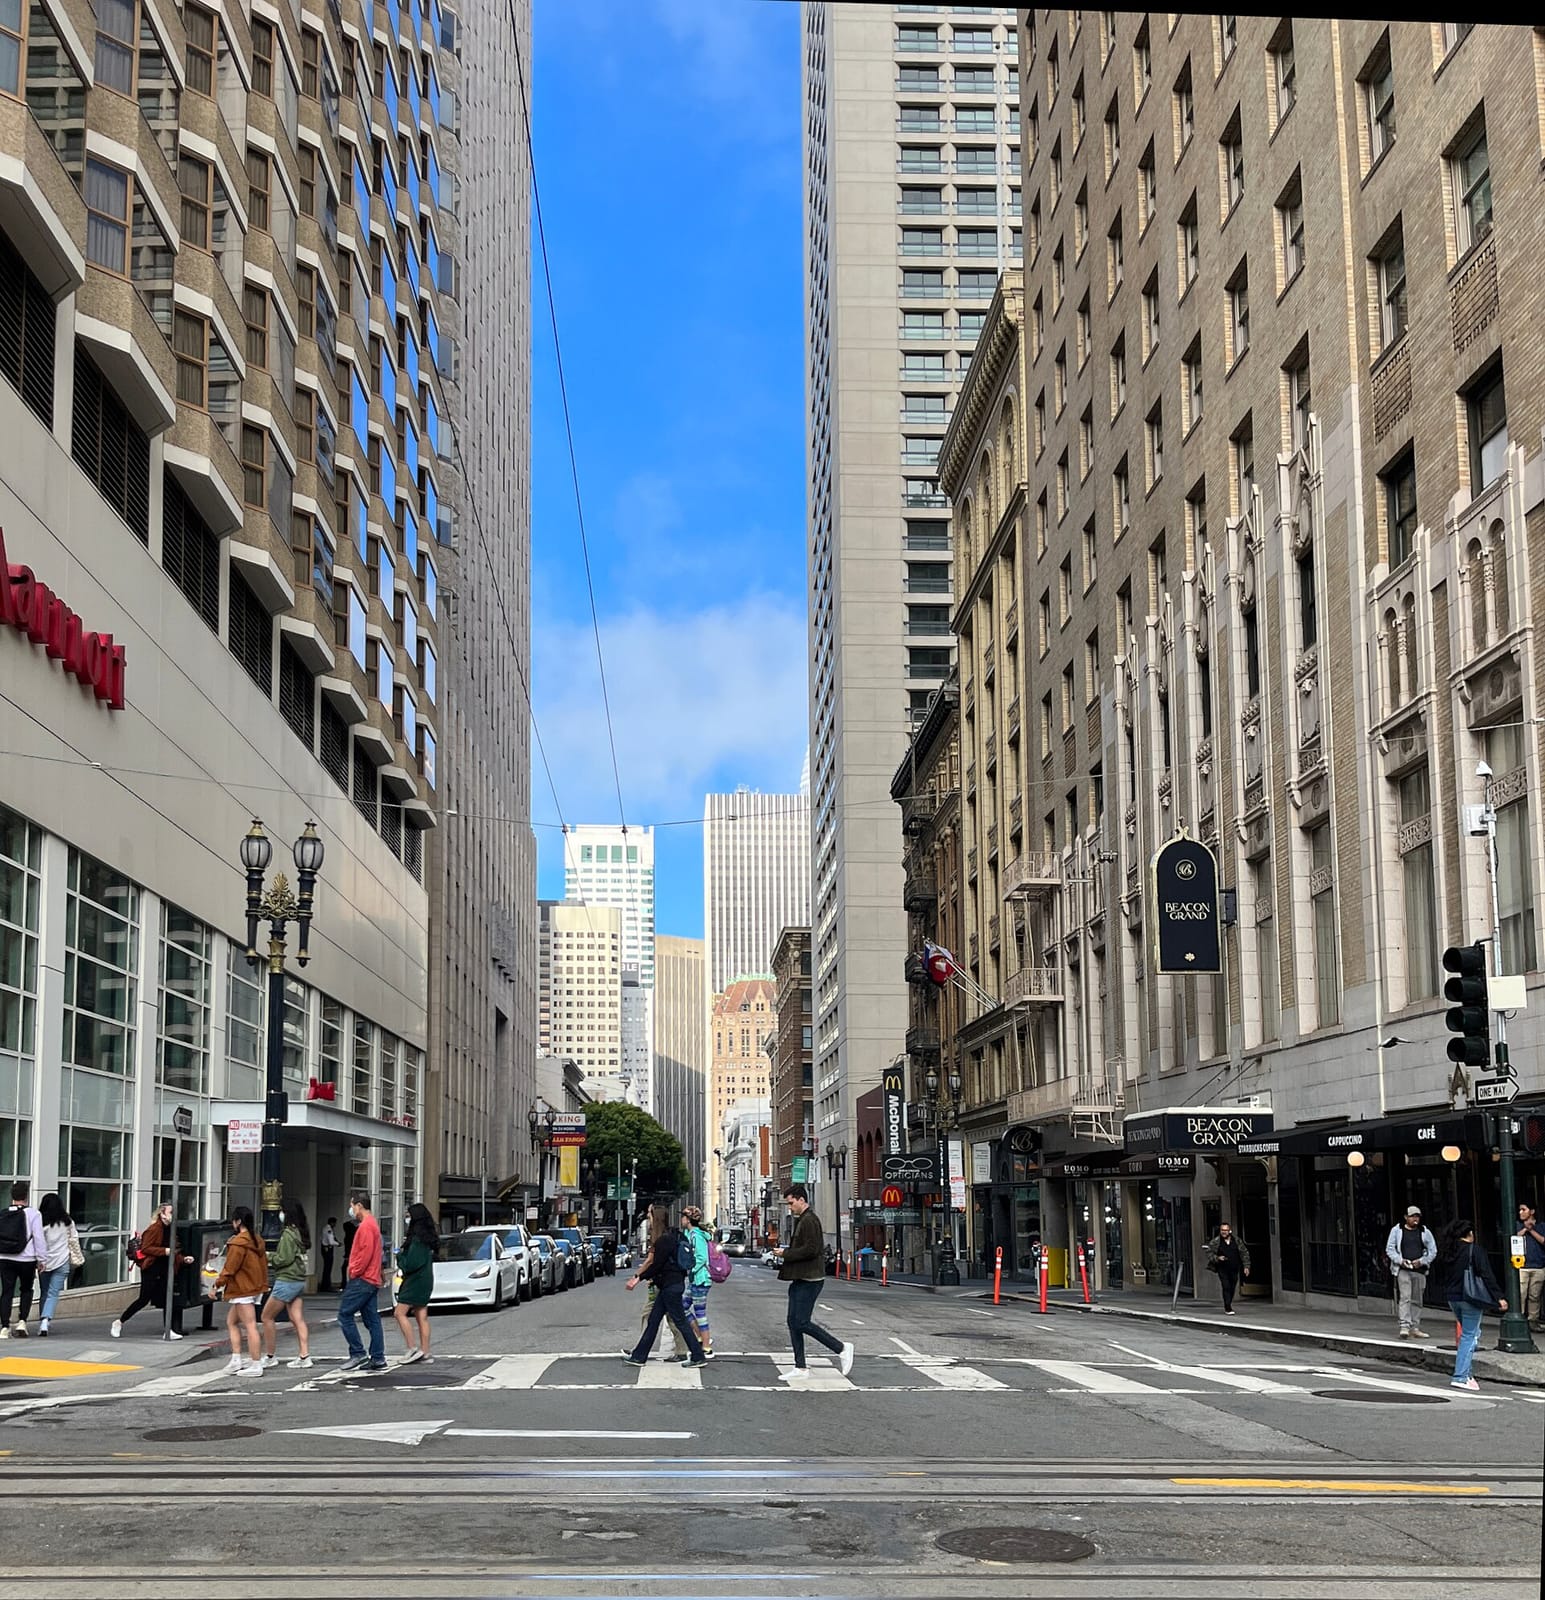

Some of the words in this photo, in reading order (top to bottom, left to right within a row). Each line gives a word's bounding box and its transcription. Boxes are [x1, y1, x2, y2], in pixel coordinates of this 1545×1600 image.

[0, 527, 127, 710] arriott
[1165, 902, 1210, 913] BEACON
[1169, 911, 1208, 921] GRAND
[1480, 1087, 1492, 1098] ONE
[1493, 1085, 1506, 1095] WAY
[541, 1115, 581, 1123] PKING
[1187, 1118, 1252, 1133] BEACON
[1417, 1124, 1436, 1139] CAFÉ
[1328, 1134, 1363, 1146] CAPPUCCINO
[1238, 1144, 1263, 1154] STARBUCKS
[1263, 1142, 1280, 1152] COFFEE
[1158, 1157, 1190, 1165] UOMO
[1064, 1164, 1089, 1172] UOMO
[885, 1172, 934, 1180] OPTICIANS
